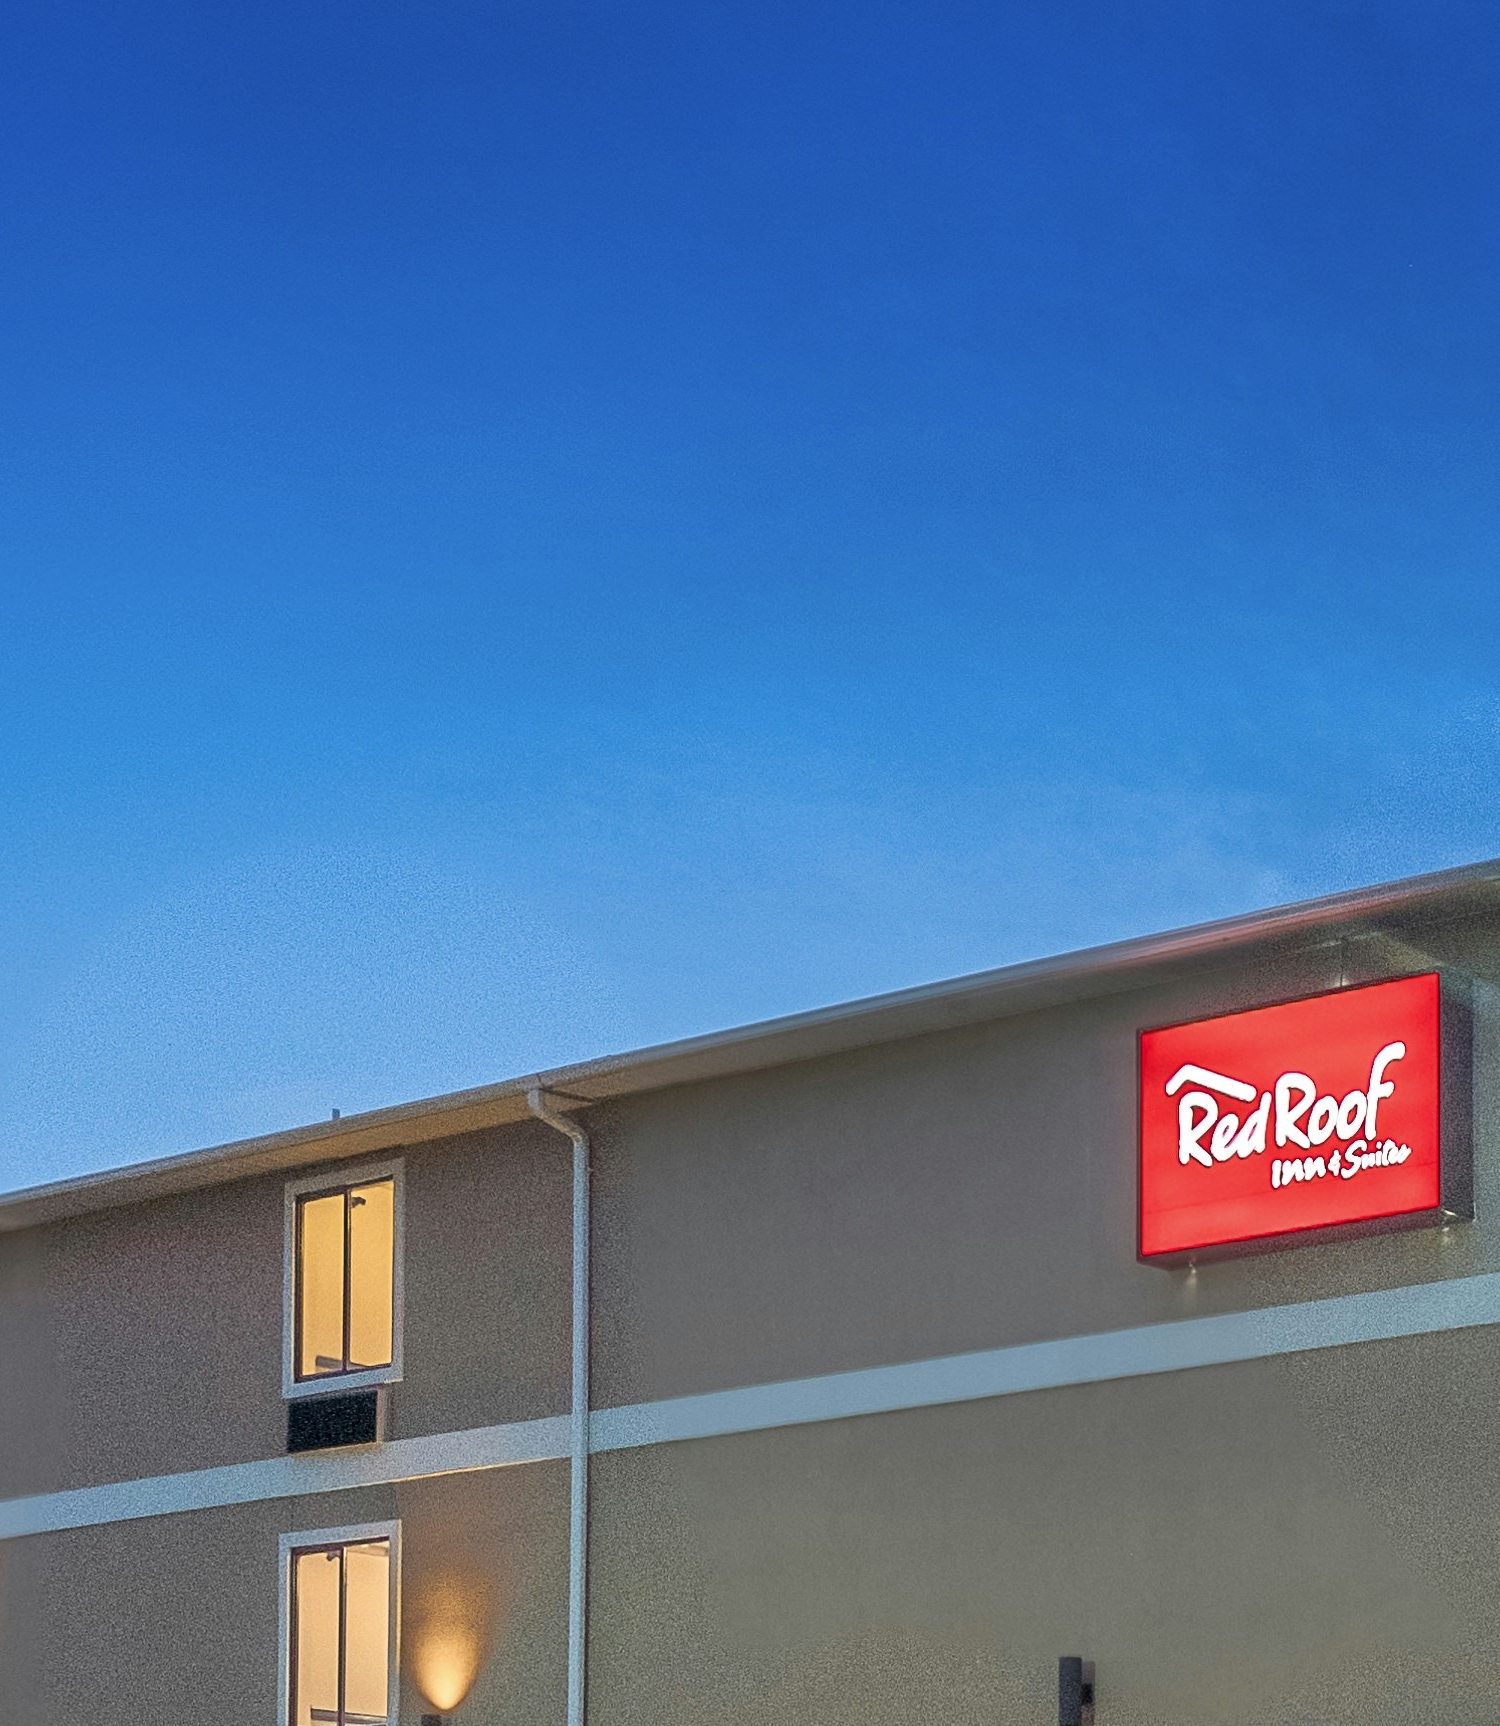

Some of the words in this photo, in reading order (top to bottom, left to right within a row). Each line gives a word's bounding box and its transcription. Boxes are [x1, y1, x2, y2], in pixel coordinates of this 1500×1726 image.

[1179, 1091, 1272, 1167] Red
[1275, 1041, 1406, 1149] Roof
[1272, 1157, 1326, 1189] Inn
[1328, 1149, 1341, 1177] &
[1341, 1139, 1411, 1179] Suites
